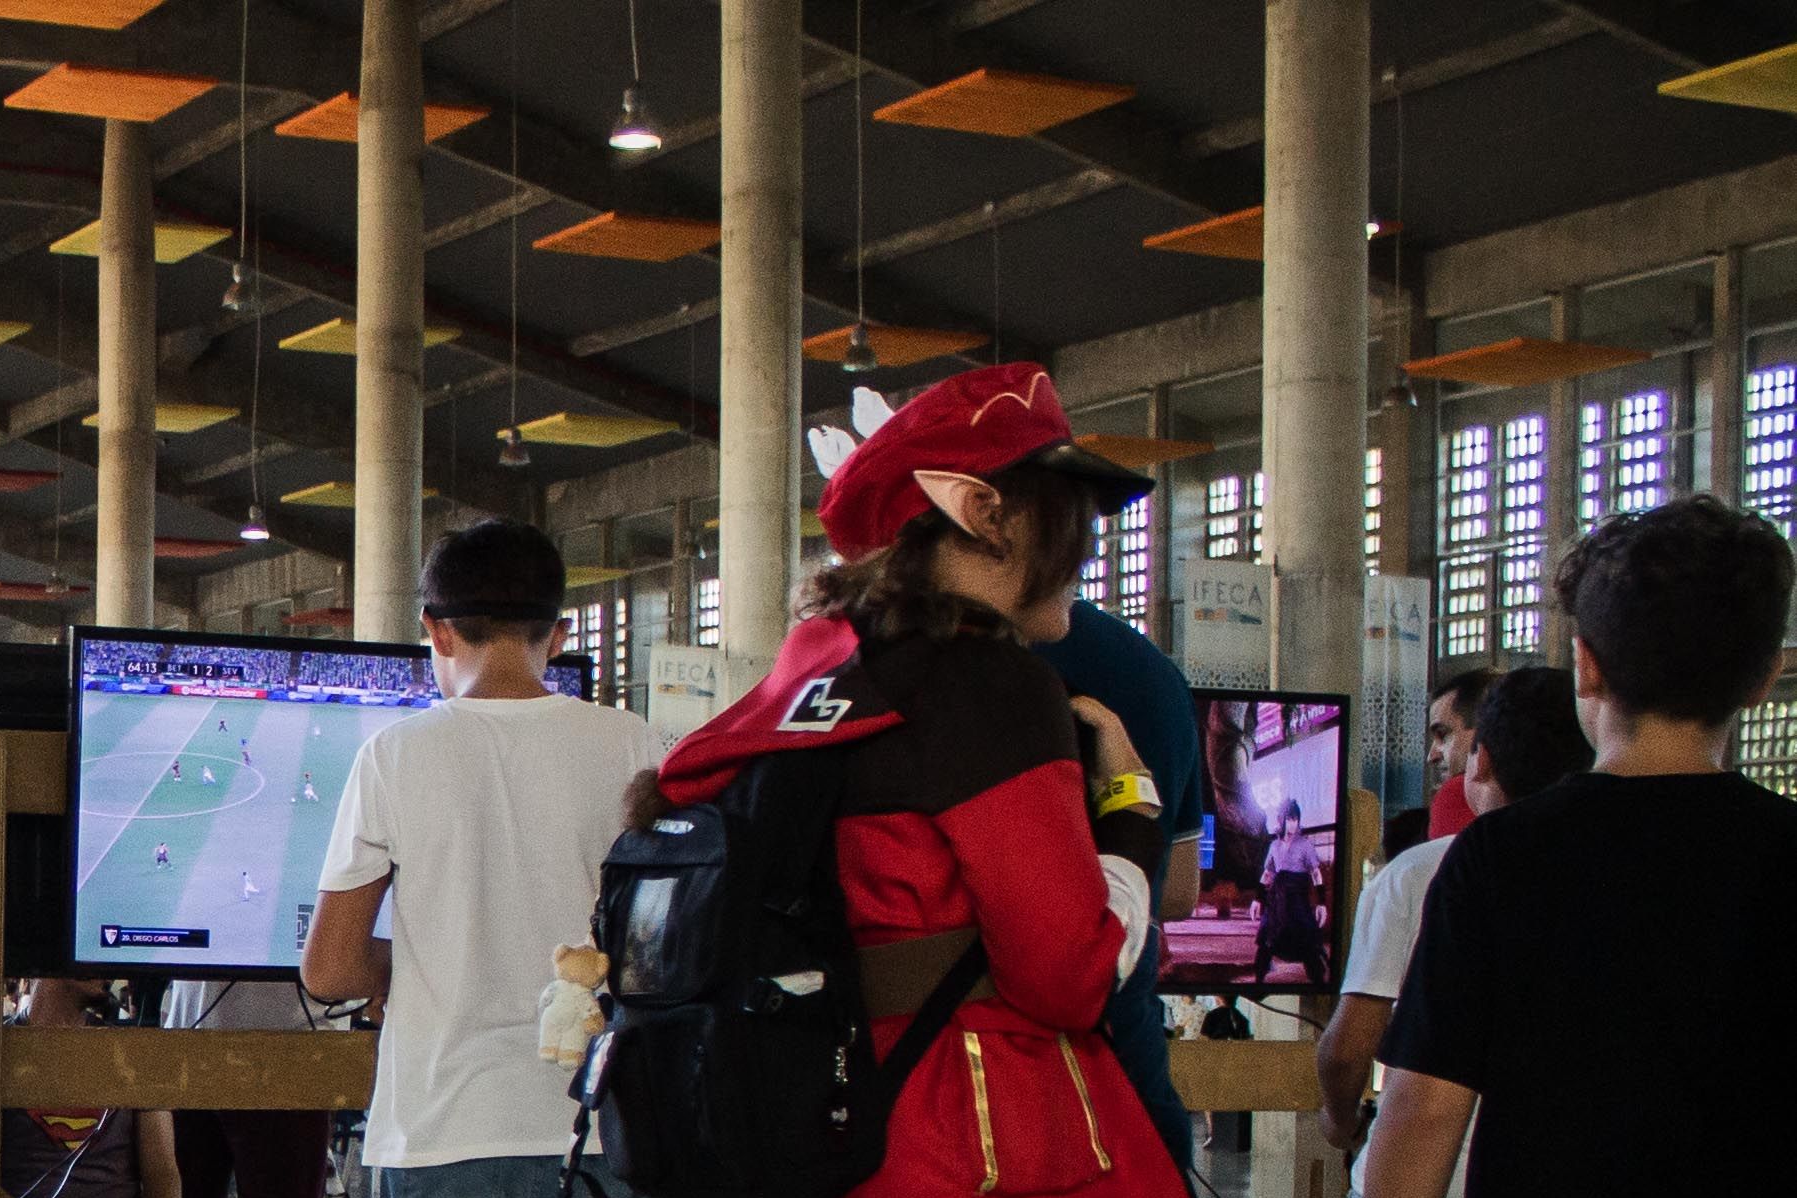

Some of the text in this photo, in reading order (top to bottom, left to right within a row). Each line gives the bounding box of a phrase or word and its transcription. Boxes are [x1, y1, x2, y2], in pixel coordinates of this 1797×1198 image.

[1193, 580, 1263, 606] IFECA
[167, 664, 182, 672] BET
[192, 665, 199, 675] 1
[205, 665, 213, 676] 2
[222, 667, 238, 676] SEV
[657, 660, 717, 682] IFECA
